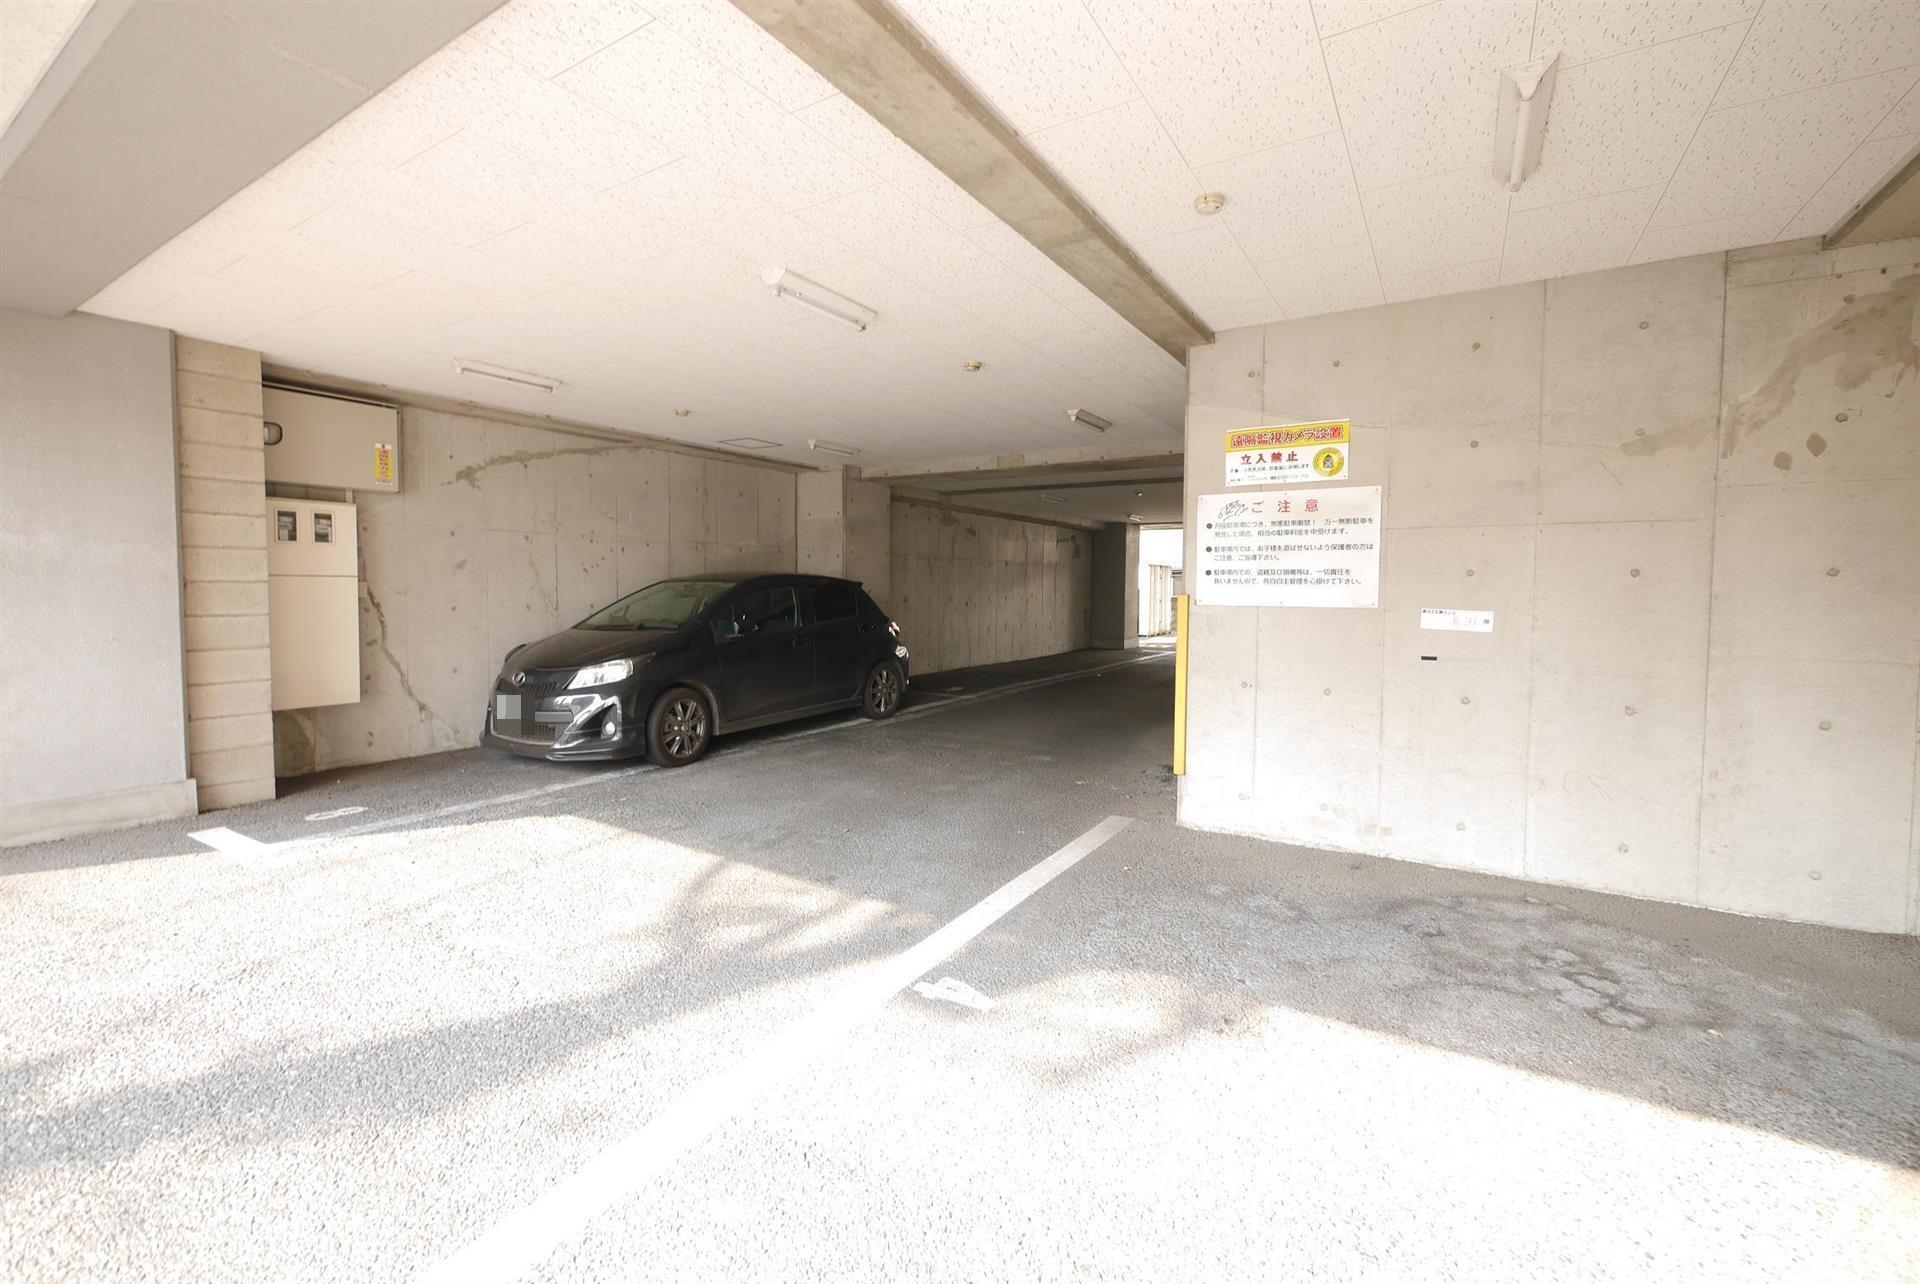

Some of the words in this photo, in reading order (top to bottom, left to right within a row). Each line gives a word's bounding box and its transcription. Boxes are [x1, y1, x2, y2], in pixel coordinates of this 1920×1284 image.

[1231, 425, 1343, 448] 遠隔監視カメラ設置
[1241, 451, 1299, 466] 立入禁止
[1251, 498, 1319, 514] ご注意
